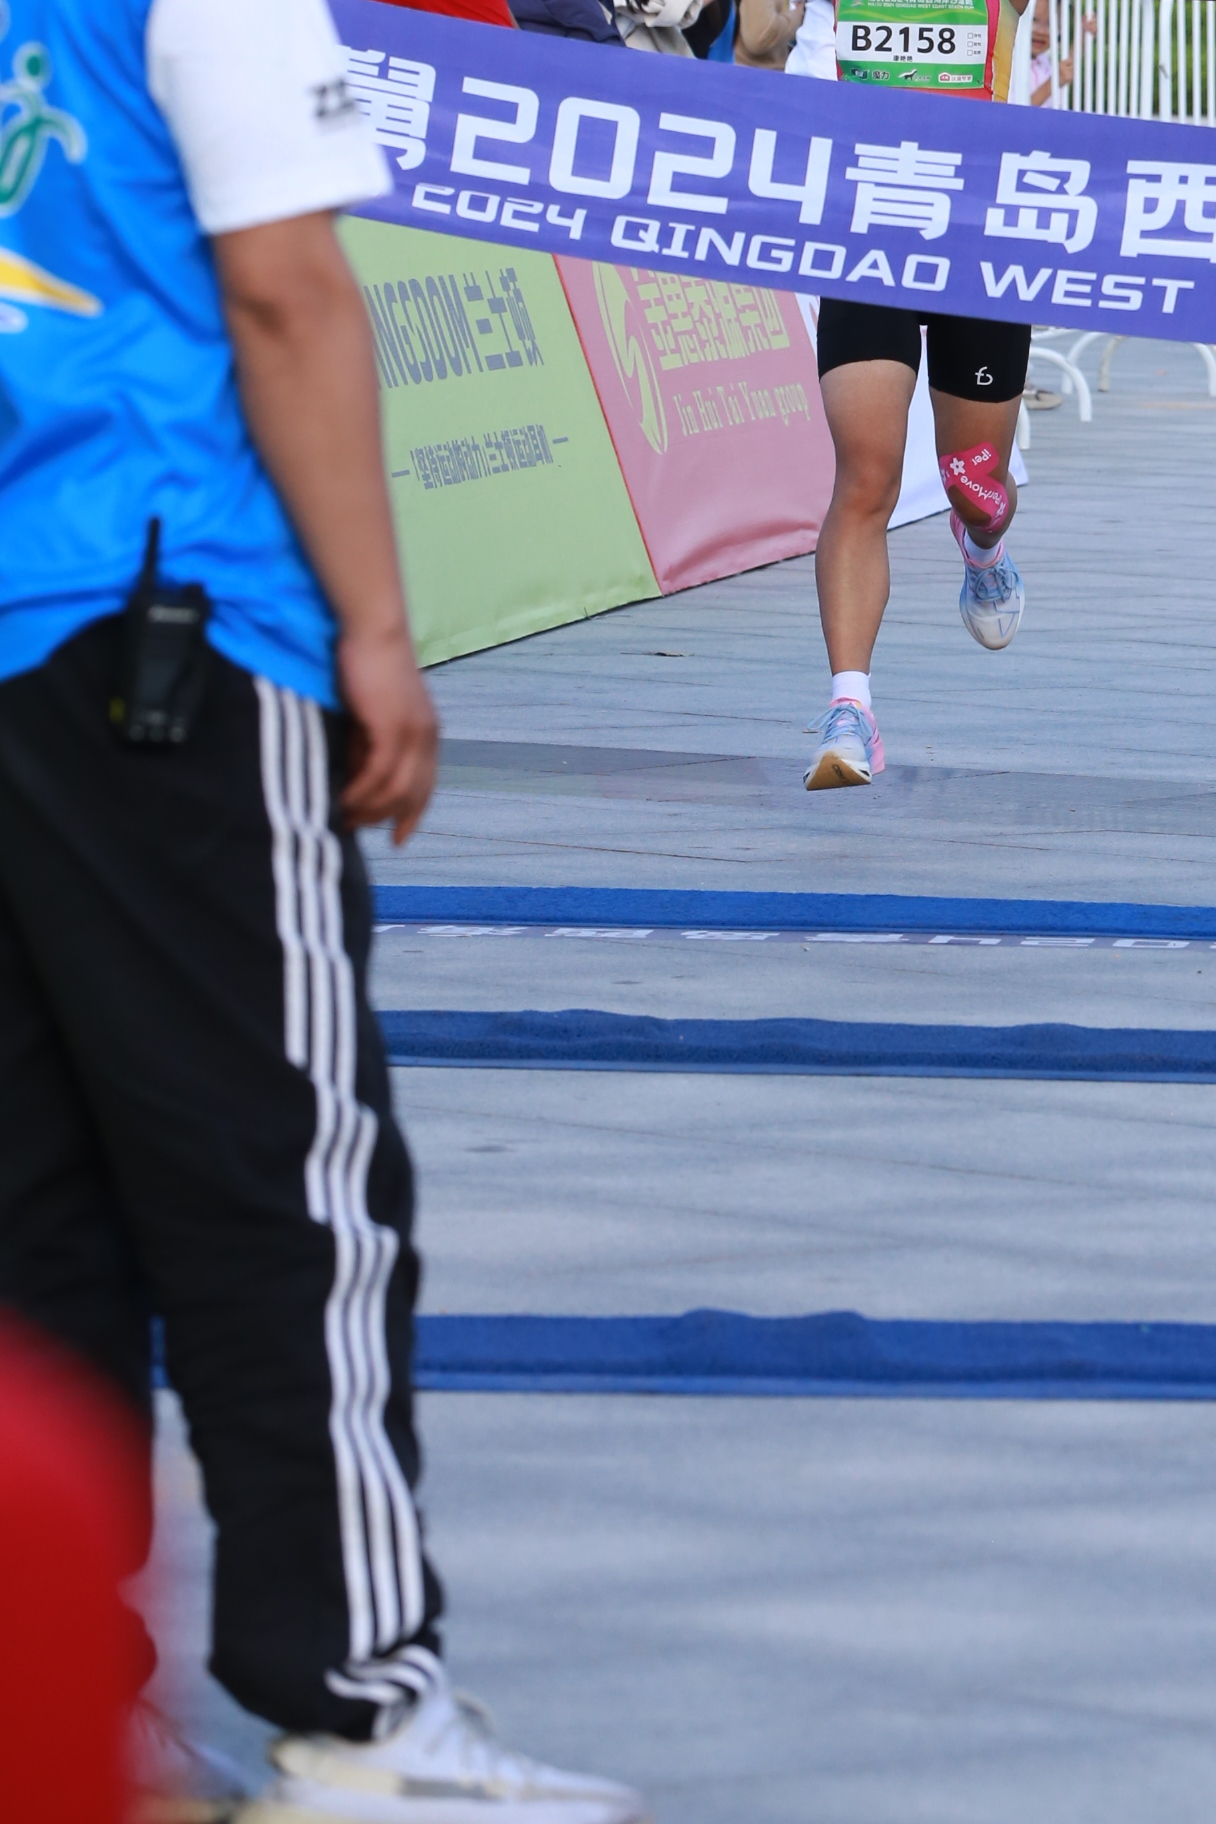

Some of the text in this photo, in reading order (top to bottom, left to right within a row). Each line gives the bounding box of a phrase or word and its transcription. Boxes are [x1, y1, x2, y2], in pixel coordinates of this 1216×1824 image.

[852, 25, 956, 54] B2158
[411, 182, 586, 240] 2024
[611, 214, 951, 293] QINGDAO
[981, 262, 1195, 315] WEST
[362, 274, 484, 393] NGSDOM
